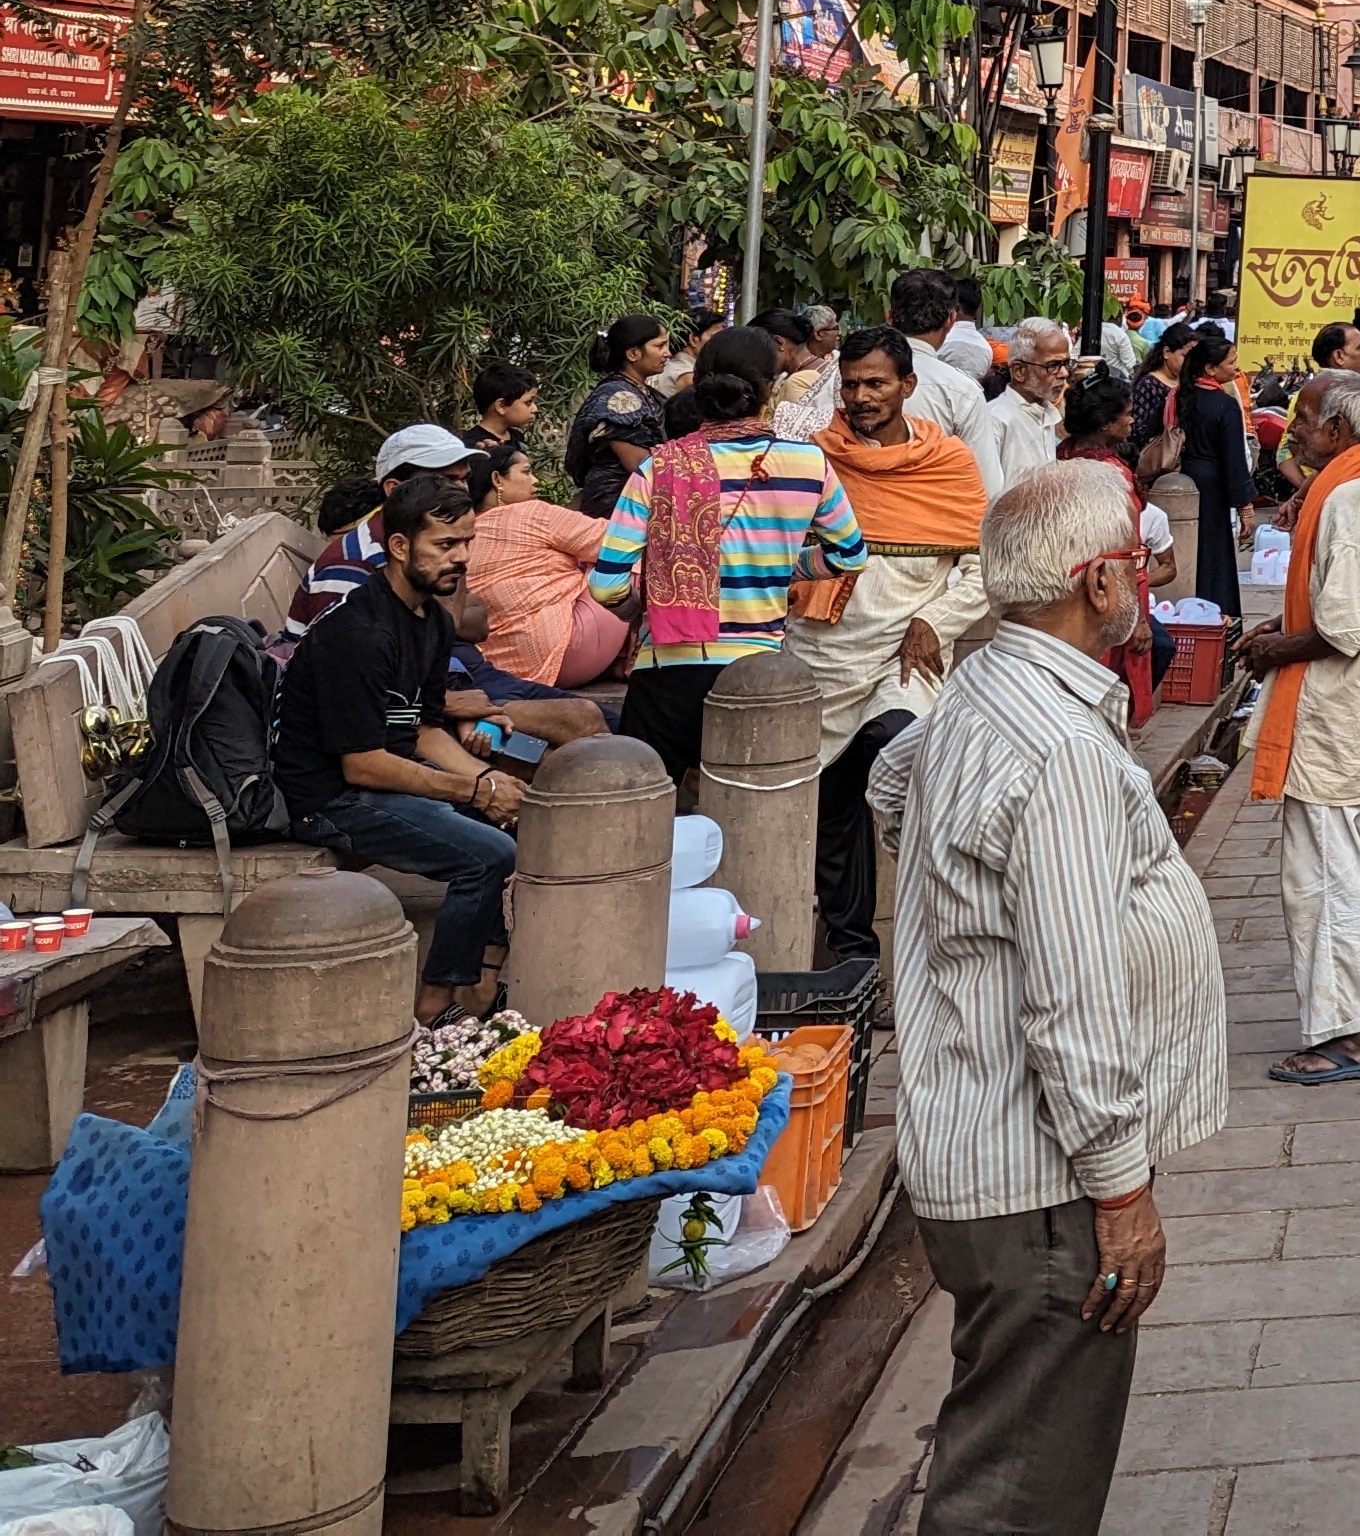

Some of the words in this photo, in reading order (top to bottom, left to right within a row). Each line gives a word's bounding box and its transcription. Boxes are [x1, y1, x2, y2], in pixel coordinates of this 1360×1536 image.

[1150, 228, 1161, 243] श्री
[1162, 230, 1183, 247] काशी
[1120, 269, 1145, 281] TOURS
[1109, 282, 1138, 294] RAVELS
